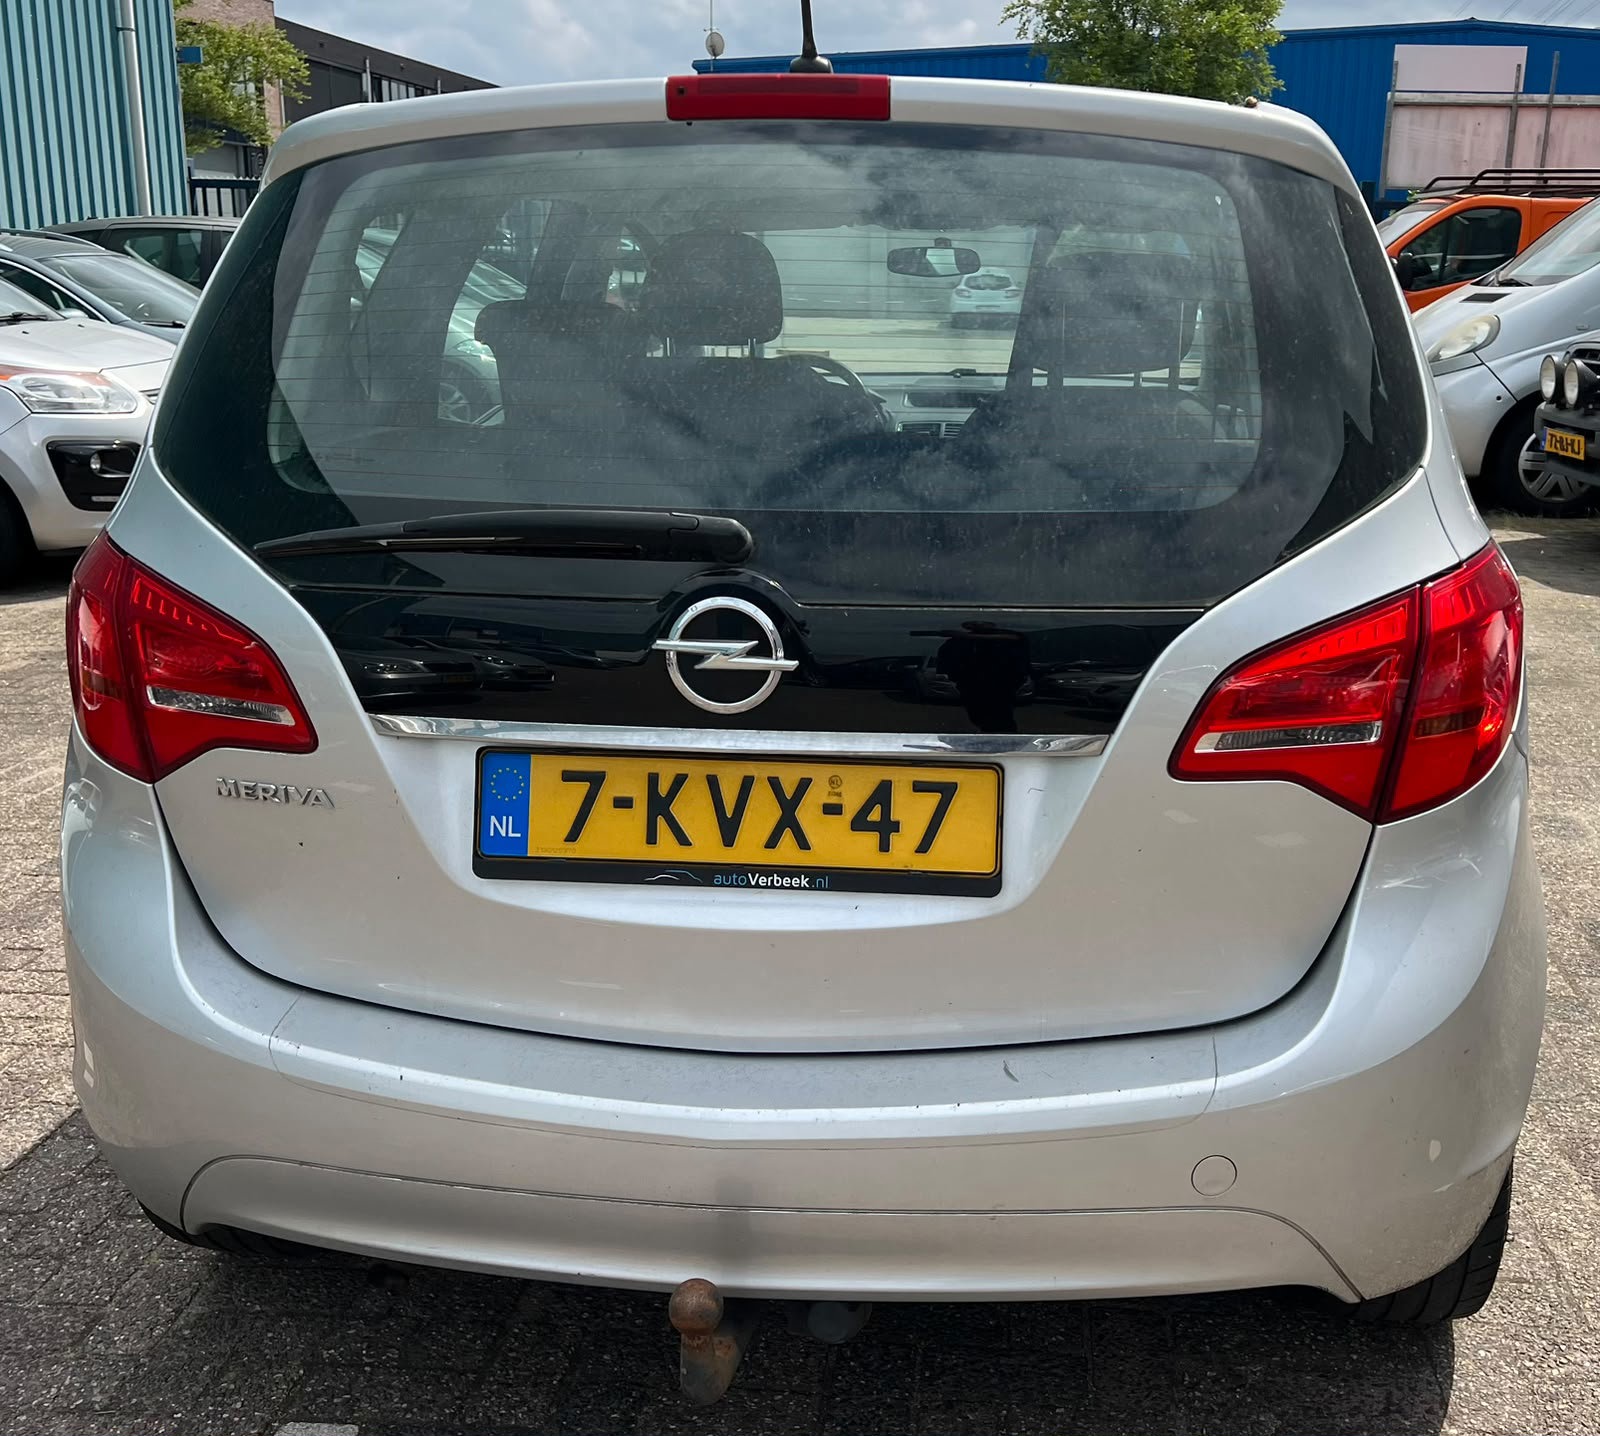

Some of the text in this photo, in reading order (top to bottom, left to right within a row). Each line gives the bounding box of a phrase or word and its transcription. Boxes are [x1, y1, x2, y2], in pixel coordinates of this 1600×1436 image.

[216, 777, 335, 808] MERIVA
[562, 770, 958, 854] 7-KVX-47
[489, 815, 521, 837] NL
[713, 872, 829, 889] autoVerbeek.nl
